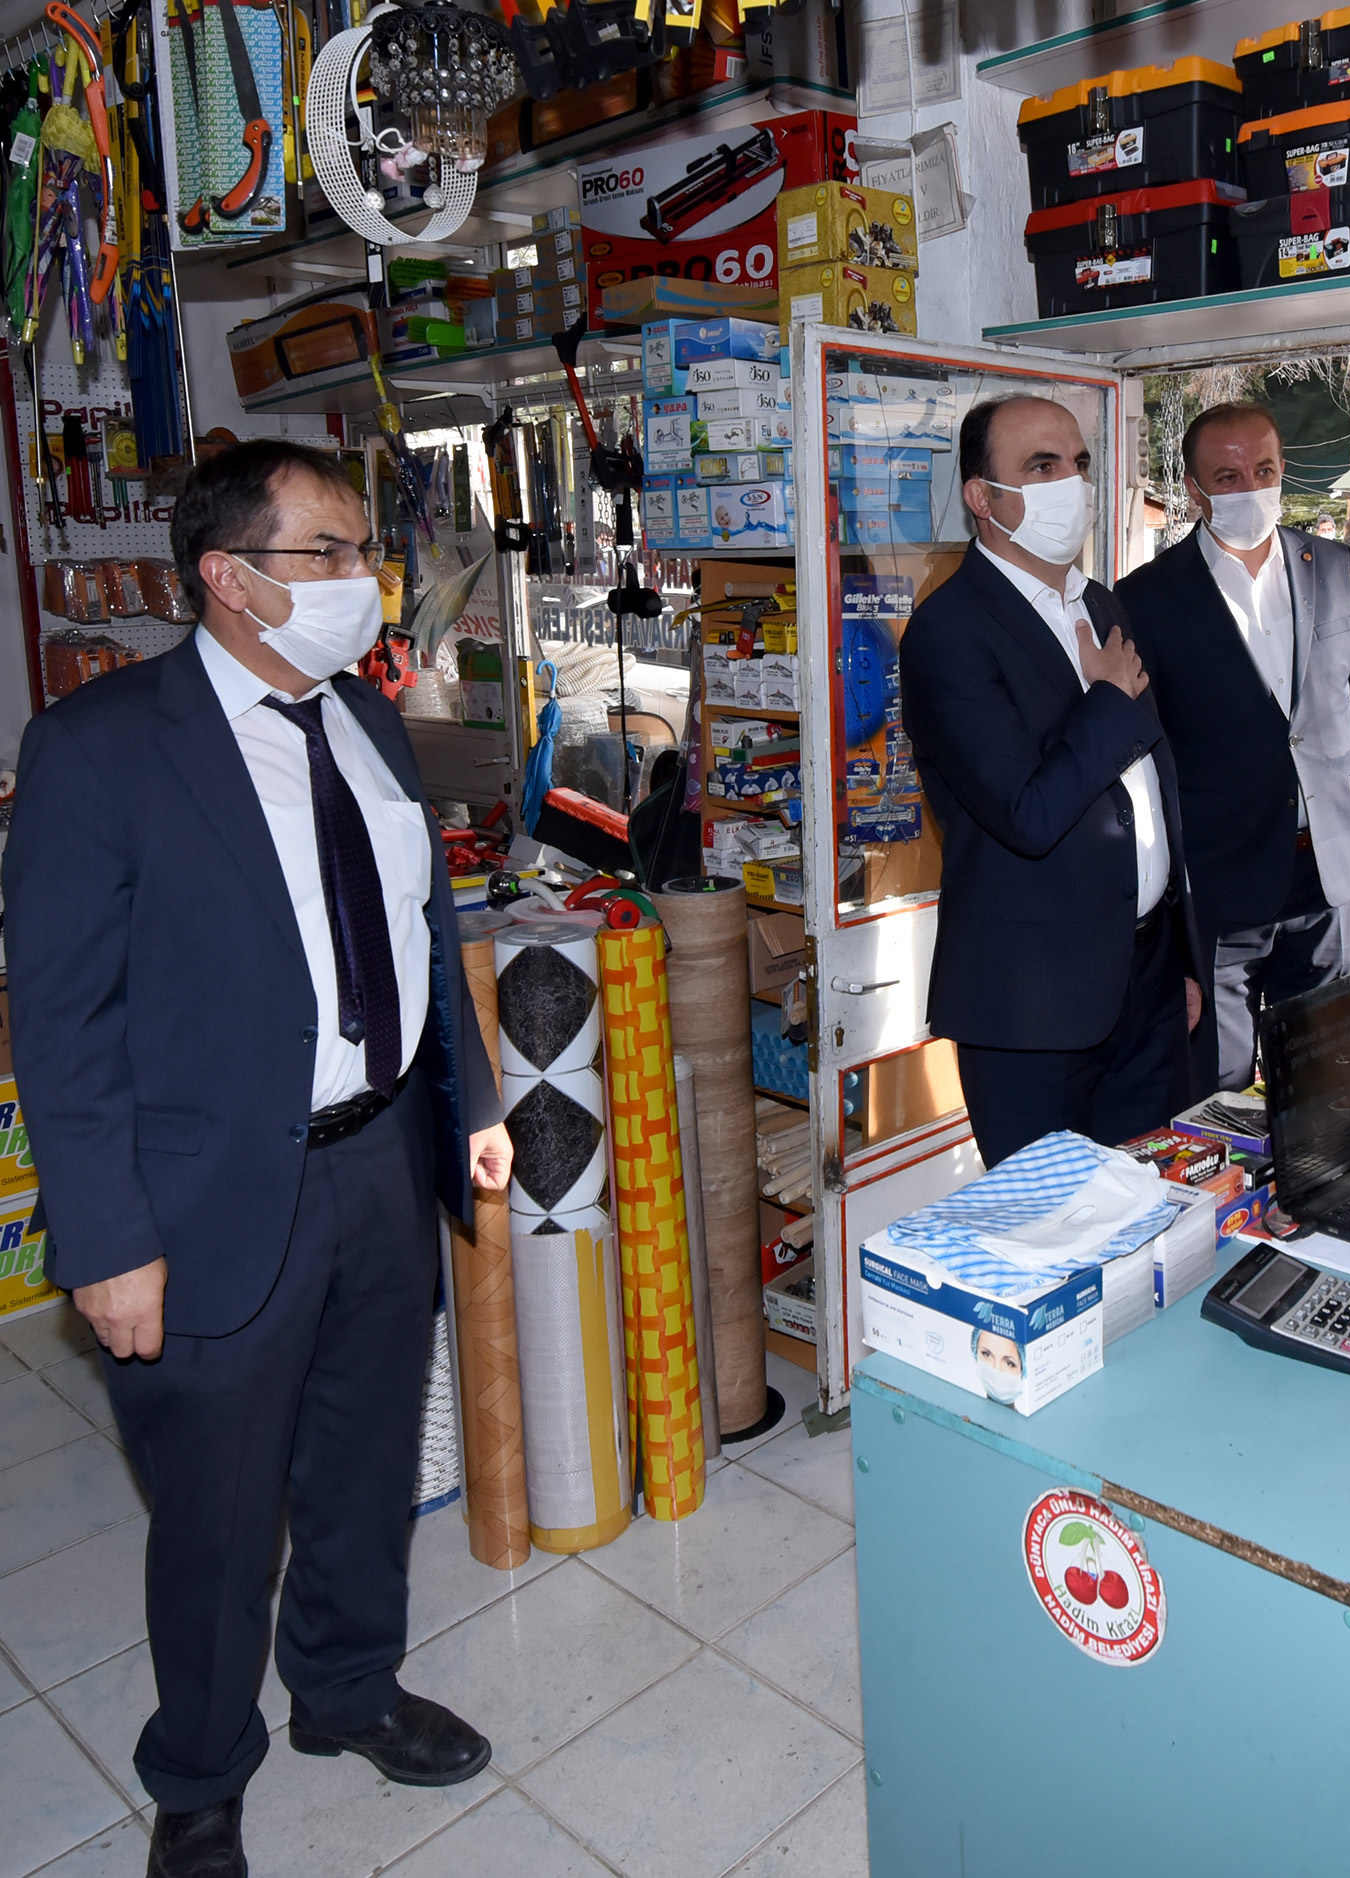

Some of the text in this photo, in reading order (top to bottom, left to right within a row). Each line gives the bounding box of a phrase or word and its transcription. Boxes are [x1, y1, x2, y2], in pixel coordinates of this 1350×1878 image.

[1086, 134, 1115, 148] SUPER-BAG
[1286, 143, 1320, 159] SUPER-BAG
[582, 167, 645, 199] PRO60
[1279, 232, 1319, 248] SUPER-BAG
[844, 593, 881, 604] Gillette
[864, 1256, 928, 1292] SURGICAL FACE MASK
[991, 1313, 1015, 1331] TERRA
[1045, 1304, 1064, 1322] TERRA
[991, 1325, 1015, 1340] MEDICAL
[1029, 1509, 1052, 1579] DÜNYACA
[1050, 1497, 1086, 1515] ÜNLÜ
[1089, 1507, 1135, 1550] HADİM
[1053, 1584, 1100, 1633] Hadim
[1043, 1593, 1156, 1659] HADİM BELEDİYESİ
